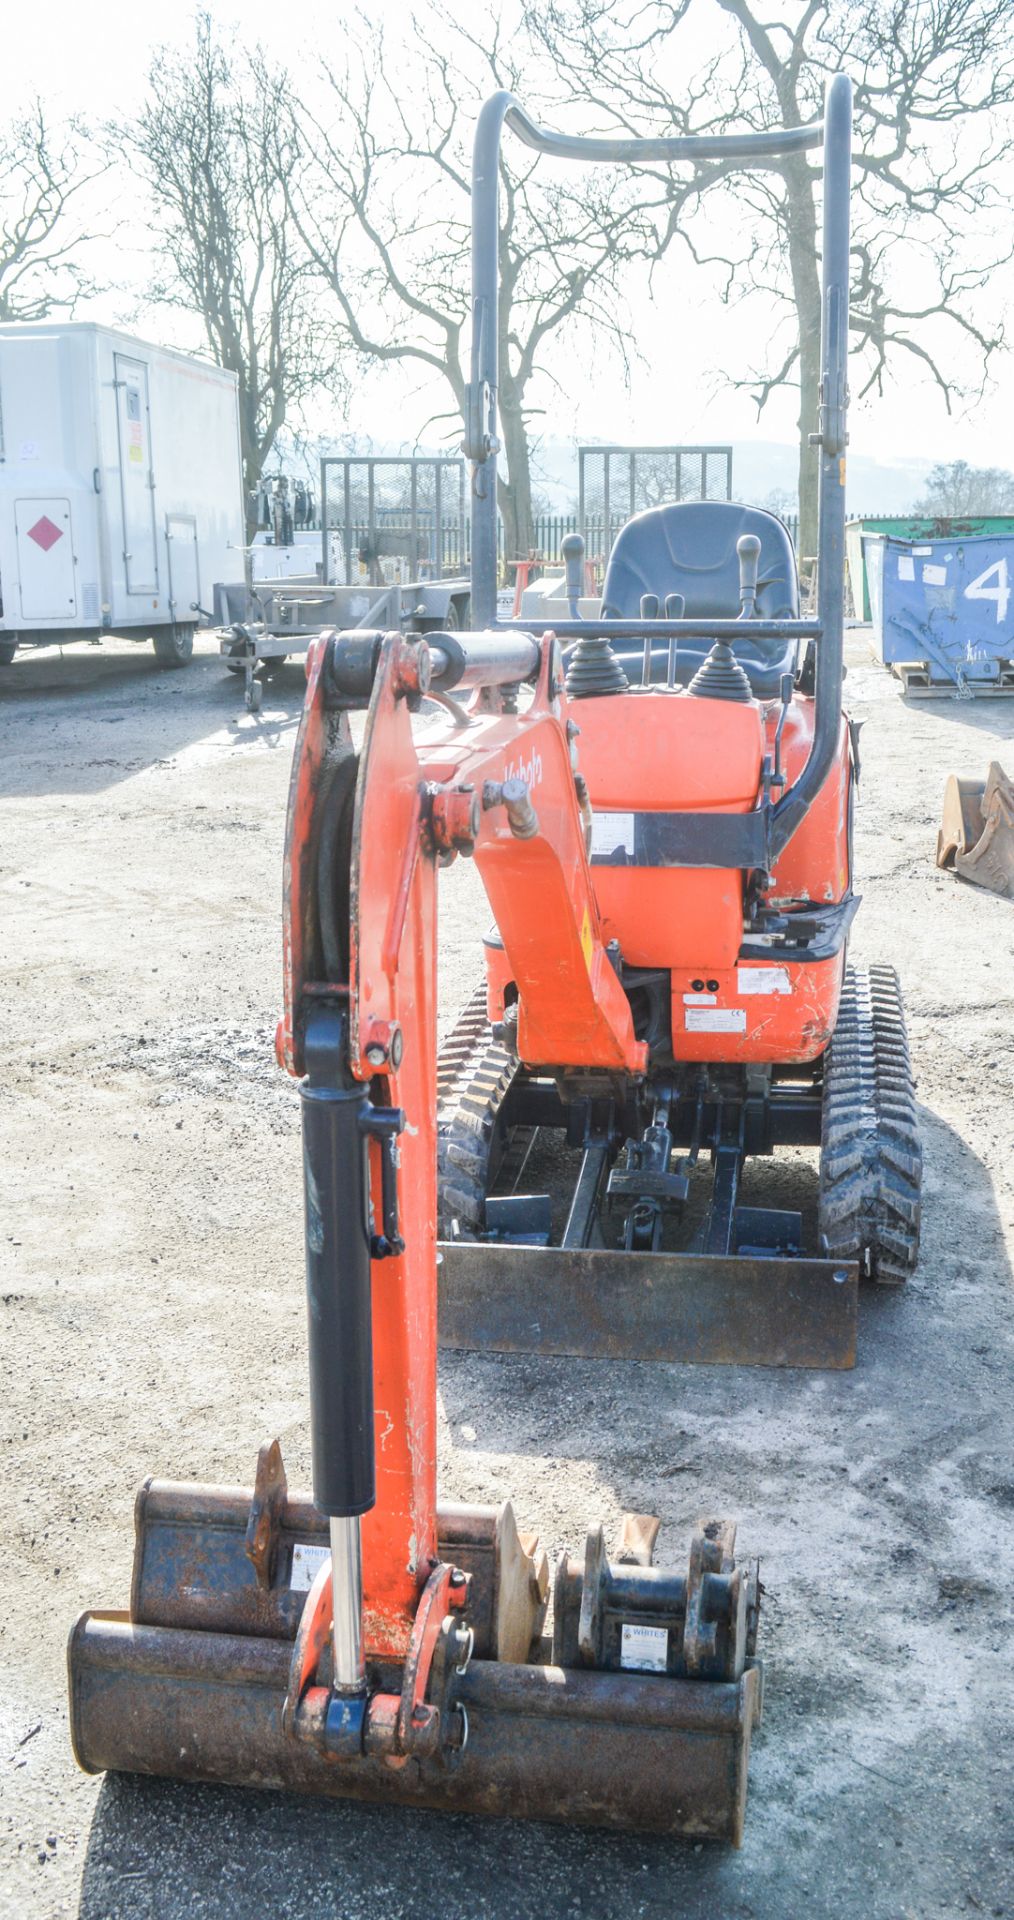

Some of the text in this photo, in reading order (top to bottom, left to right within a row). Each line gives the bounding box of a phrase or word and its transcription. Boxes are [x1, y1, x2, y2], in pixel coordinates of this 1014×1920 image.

[964, 557, 1011, 625] 4
[504, 745, 542, 791] Kubota
[304, 1547, 331, 1558] WHITE
[633, 1628, 666, 1638] WHITES
